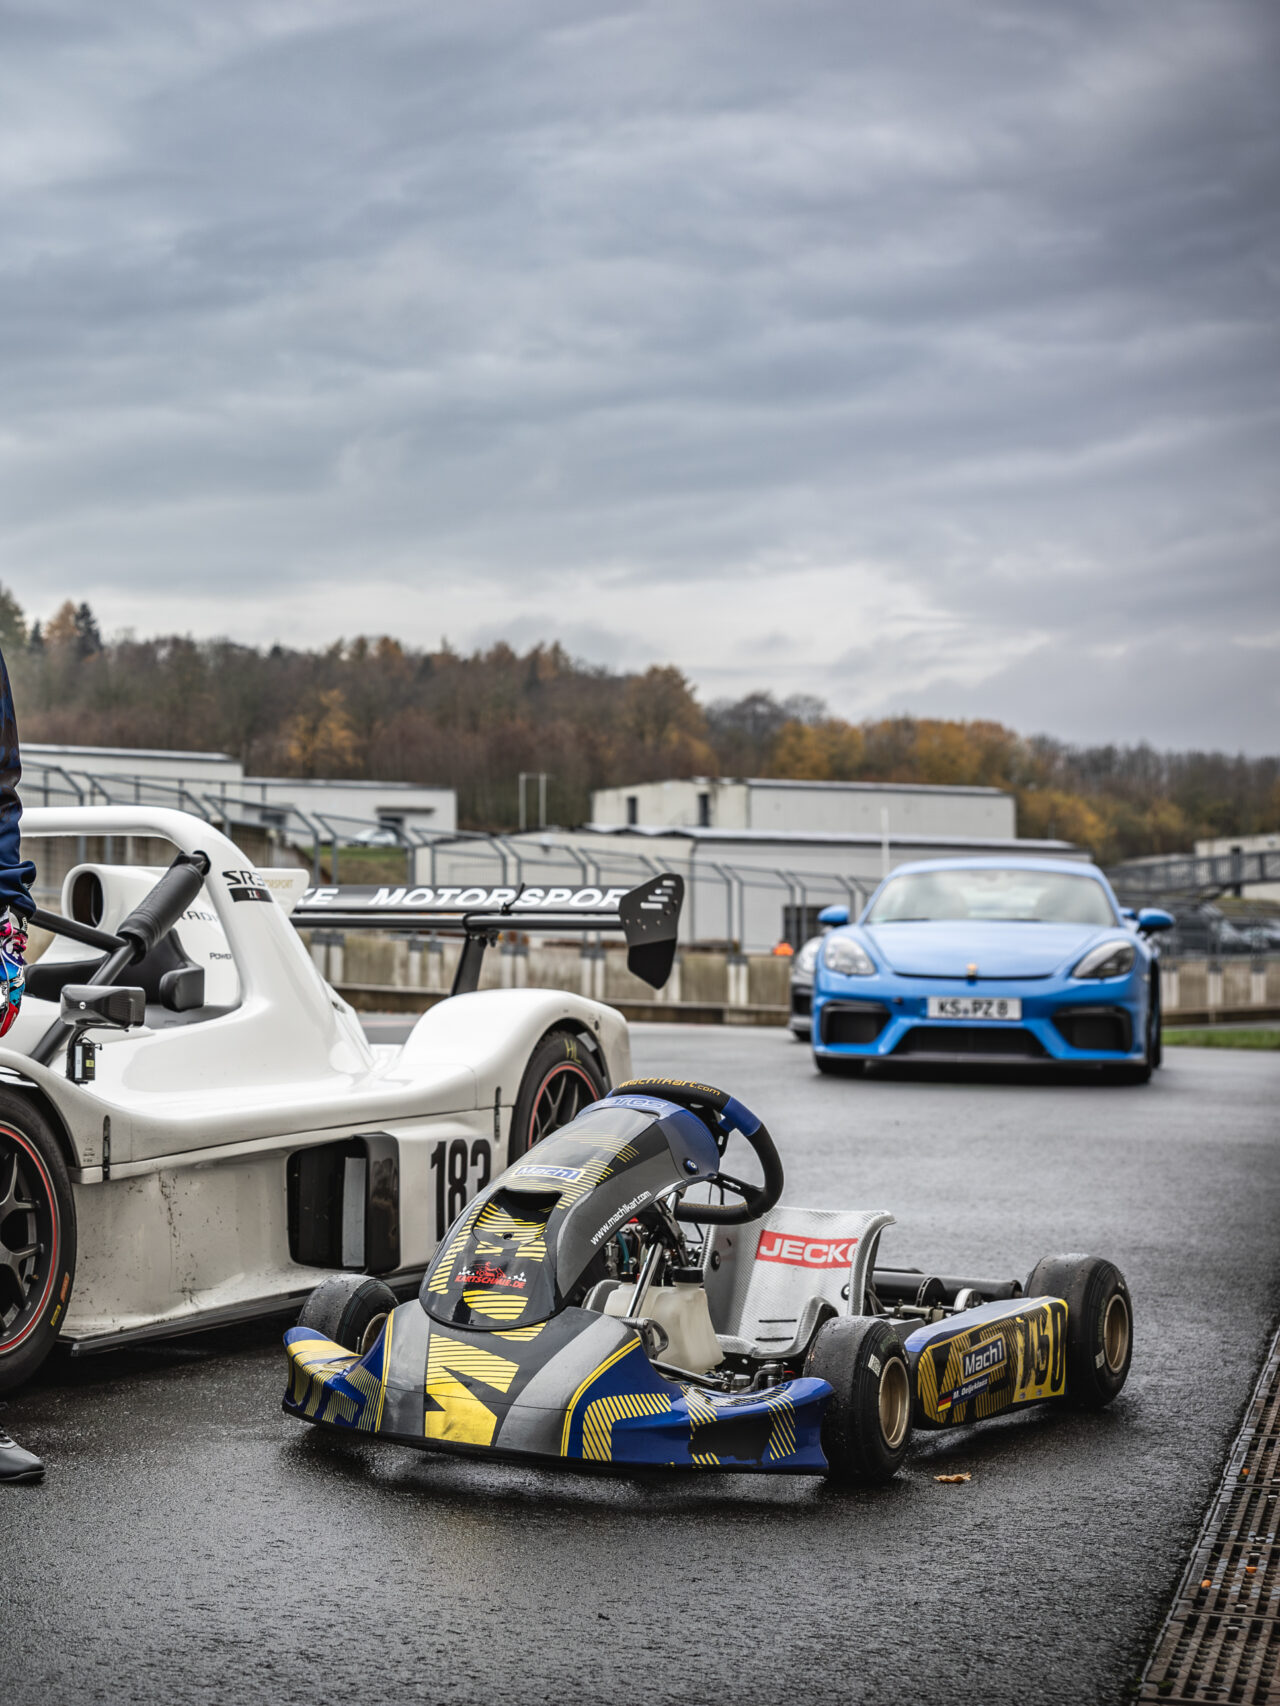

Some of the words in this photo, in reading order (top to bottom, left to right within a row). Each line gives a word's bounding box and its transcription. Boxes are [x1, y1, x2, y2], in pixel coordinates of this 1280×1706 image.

[938, 999, 961, 1016] KS
[972, 999, 993, 1016] PZ
[430, 1139, 491, 1242] 183
[590, 1190, 652, 1246] www.mach1kart.com
[965, 1340, 1002, 1376] Mach1
